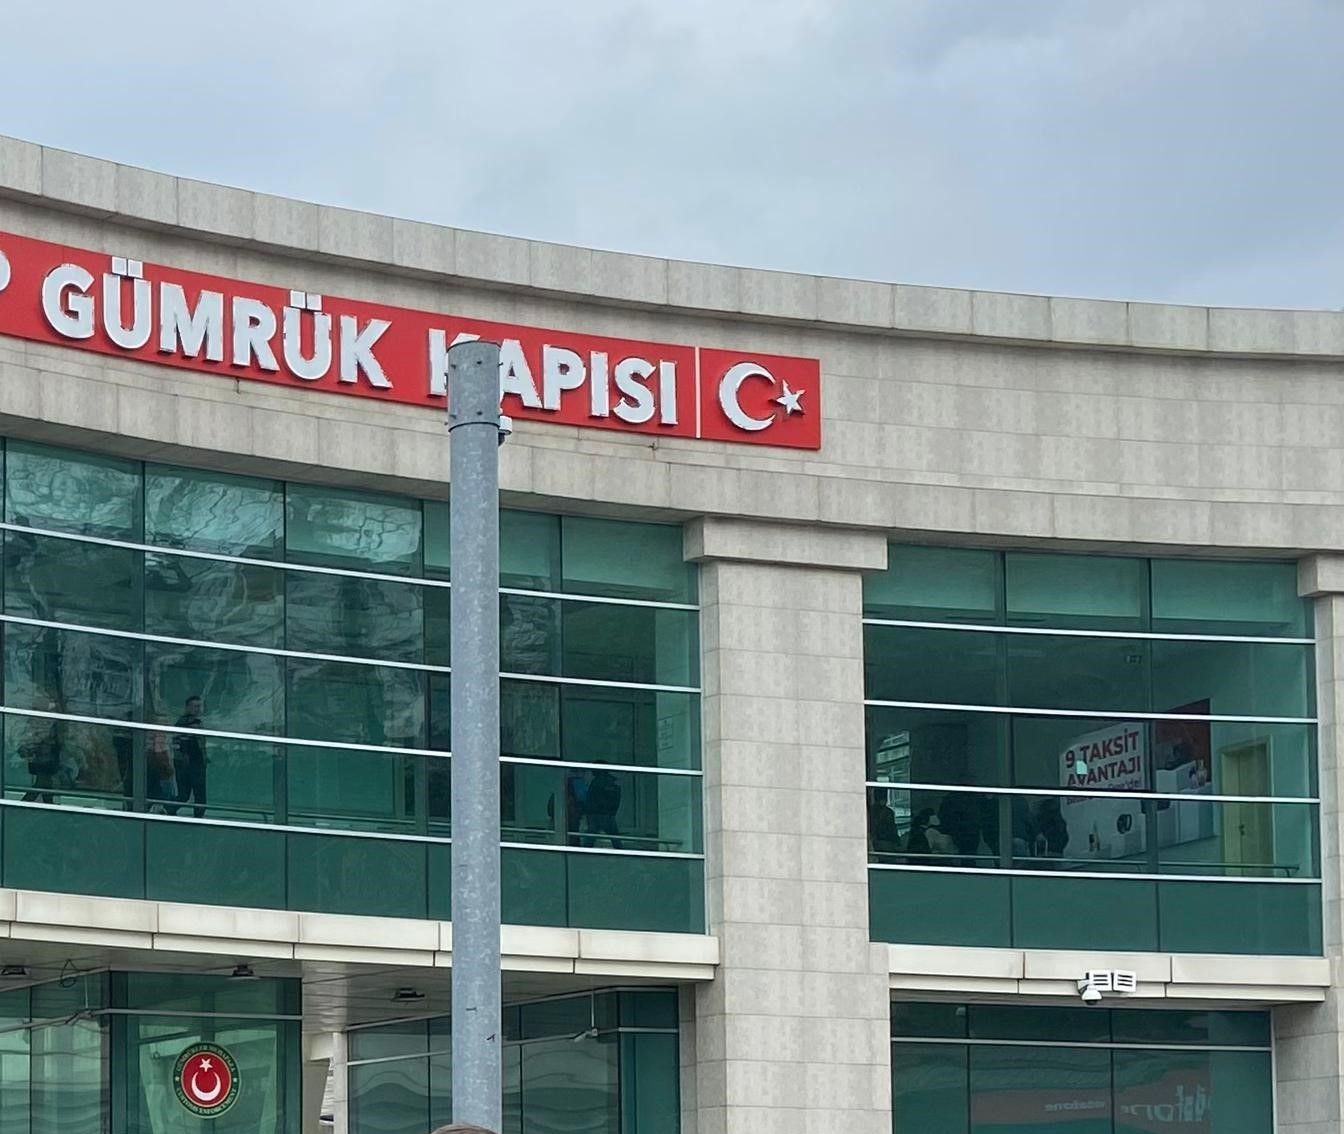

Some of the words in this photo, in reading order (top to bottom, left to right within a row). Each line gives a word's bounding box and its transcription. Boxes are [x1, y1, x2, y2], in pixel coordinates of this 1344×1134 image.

[41, 256, 394, 390] GÜMRÜK
[1065, 750, 1076, 769] 9
[1079, 728, 1140, 765] TAKSİT
[1067, 756, 1141, 787] AVANTAJI
